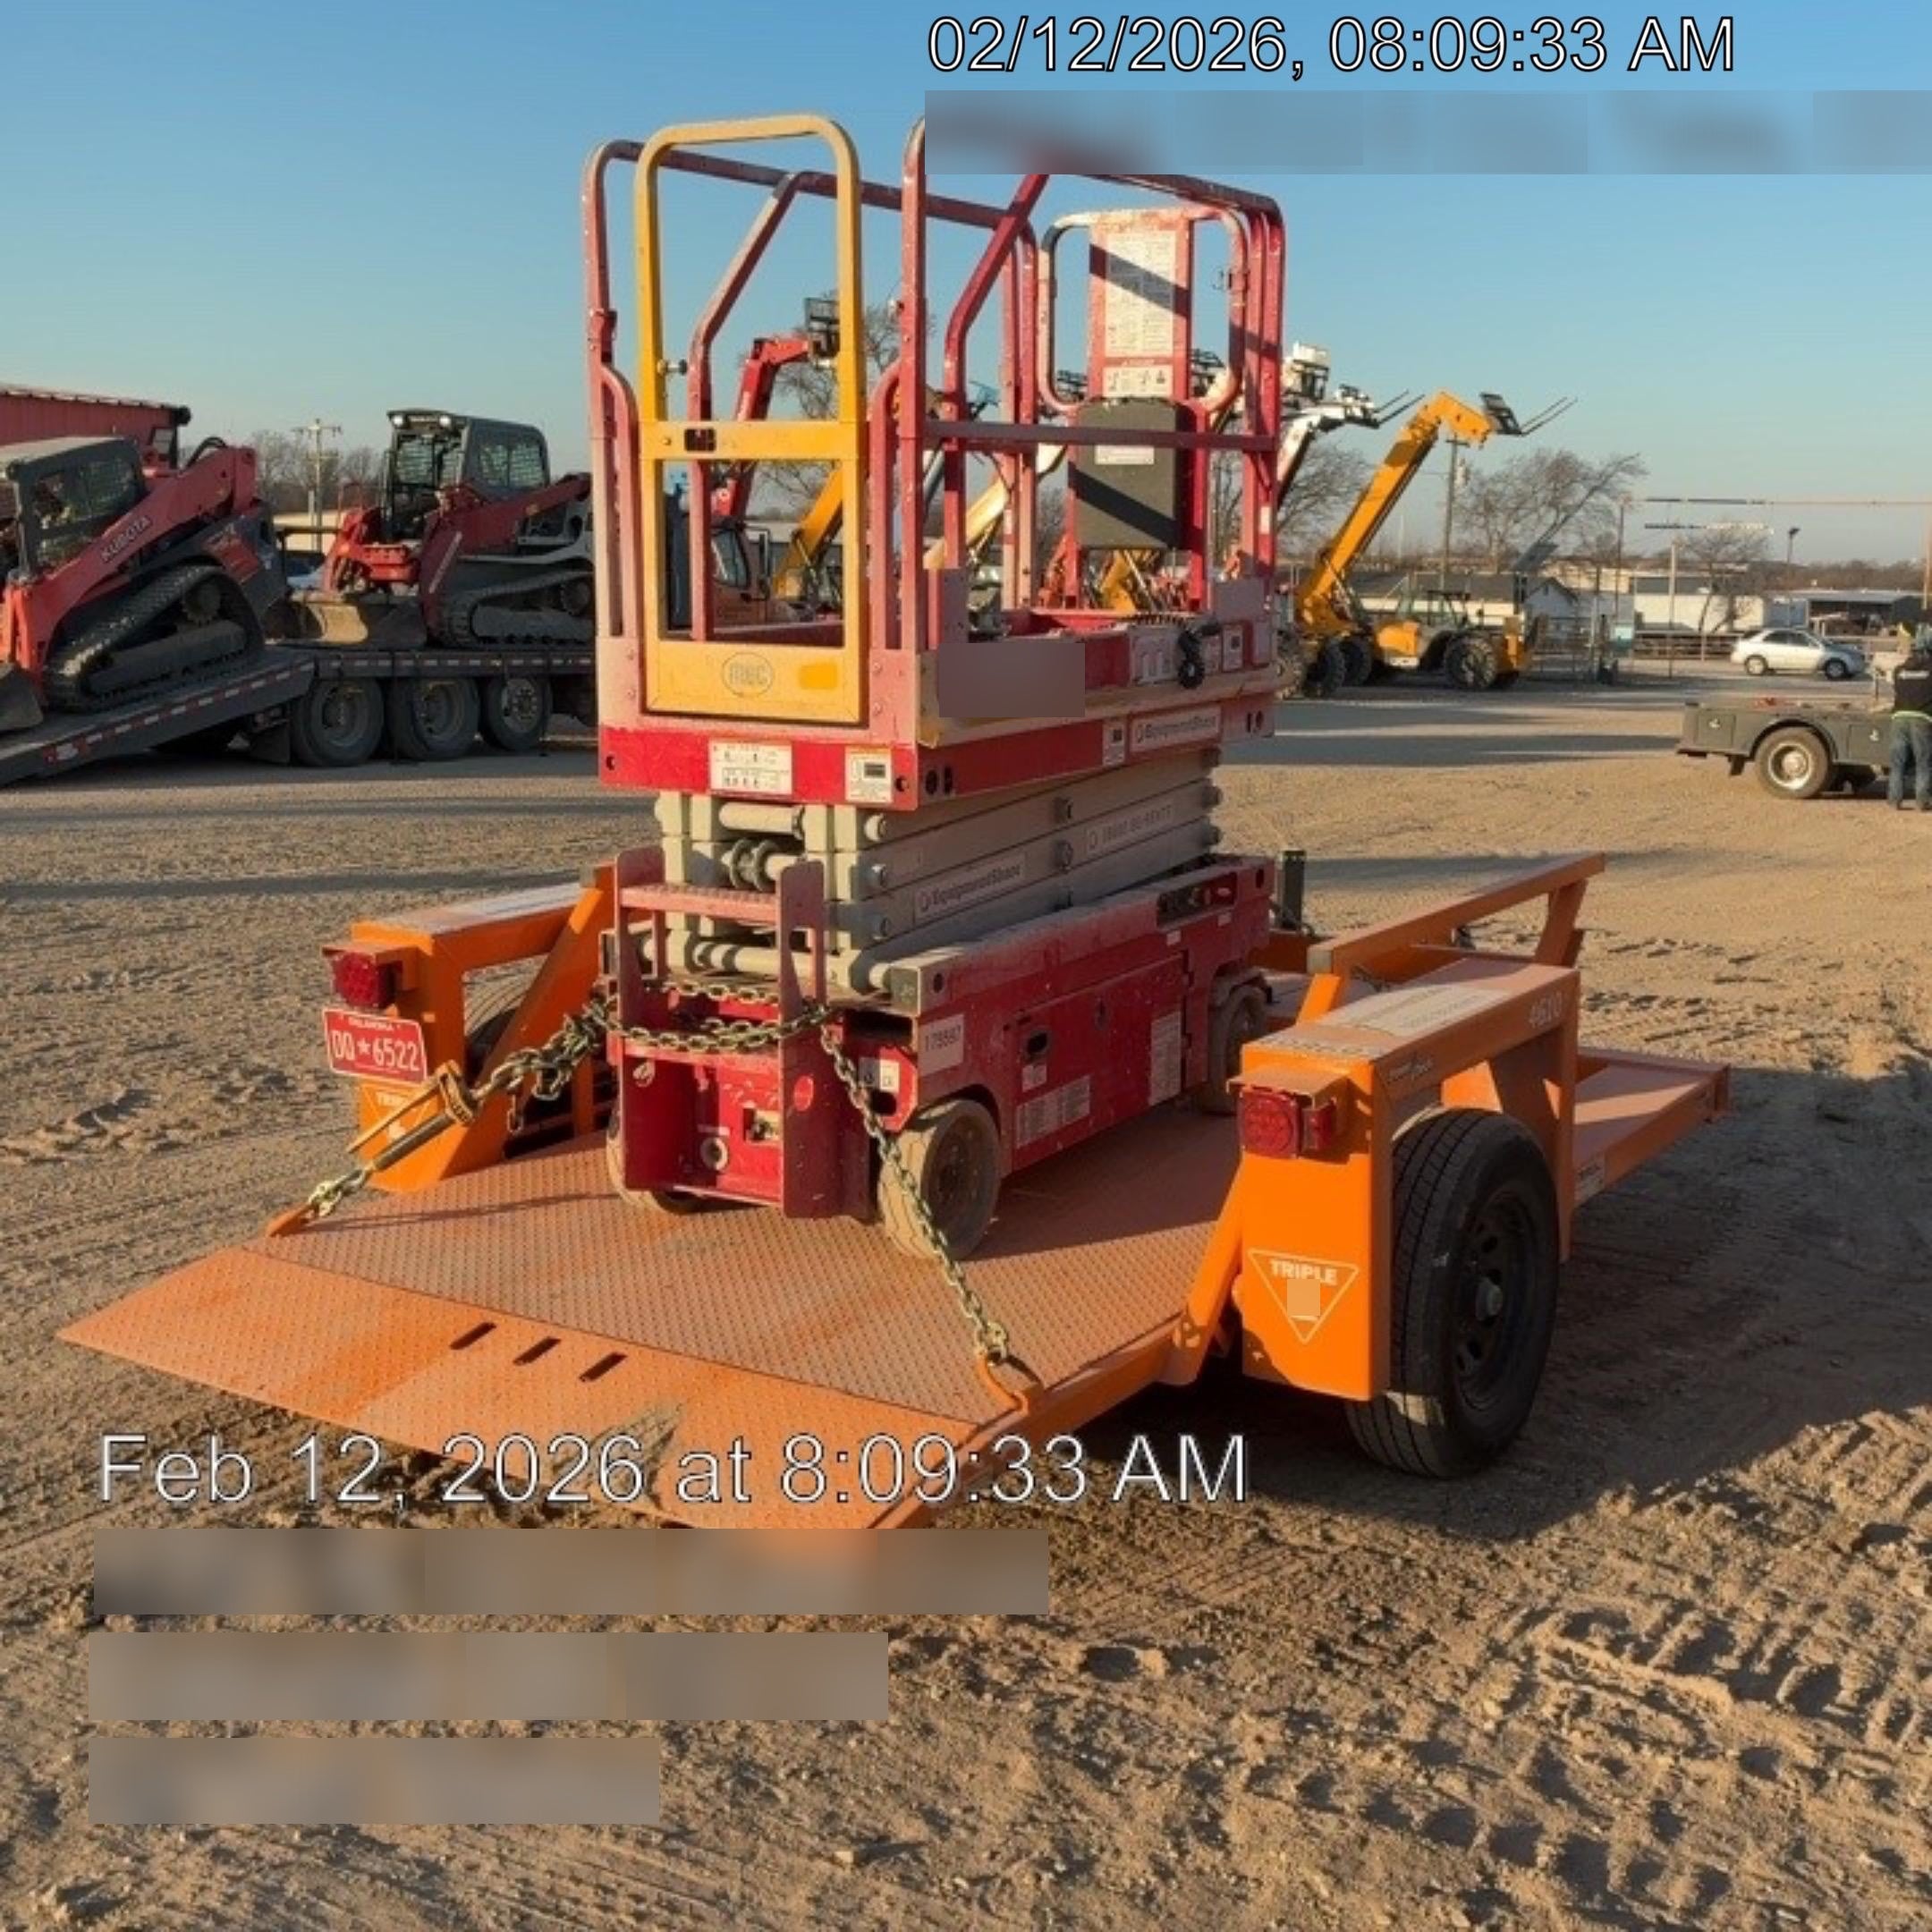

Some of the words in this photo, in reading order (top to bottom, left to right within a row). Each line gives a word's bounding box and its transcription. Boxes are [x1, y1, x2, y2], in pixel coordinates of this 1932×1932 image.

[100, 516, 151, 563] KUBOTA
[372, 1038, 420, 1072] 6522
[1270, 1258, 1338, 1287] TRIPLE
